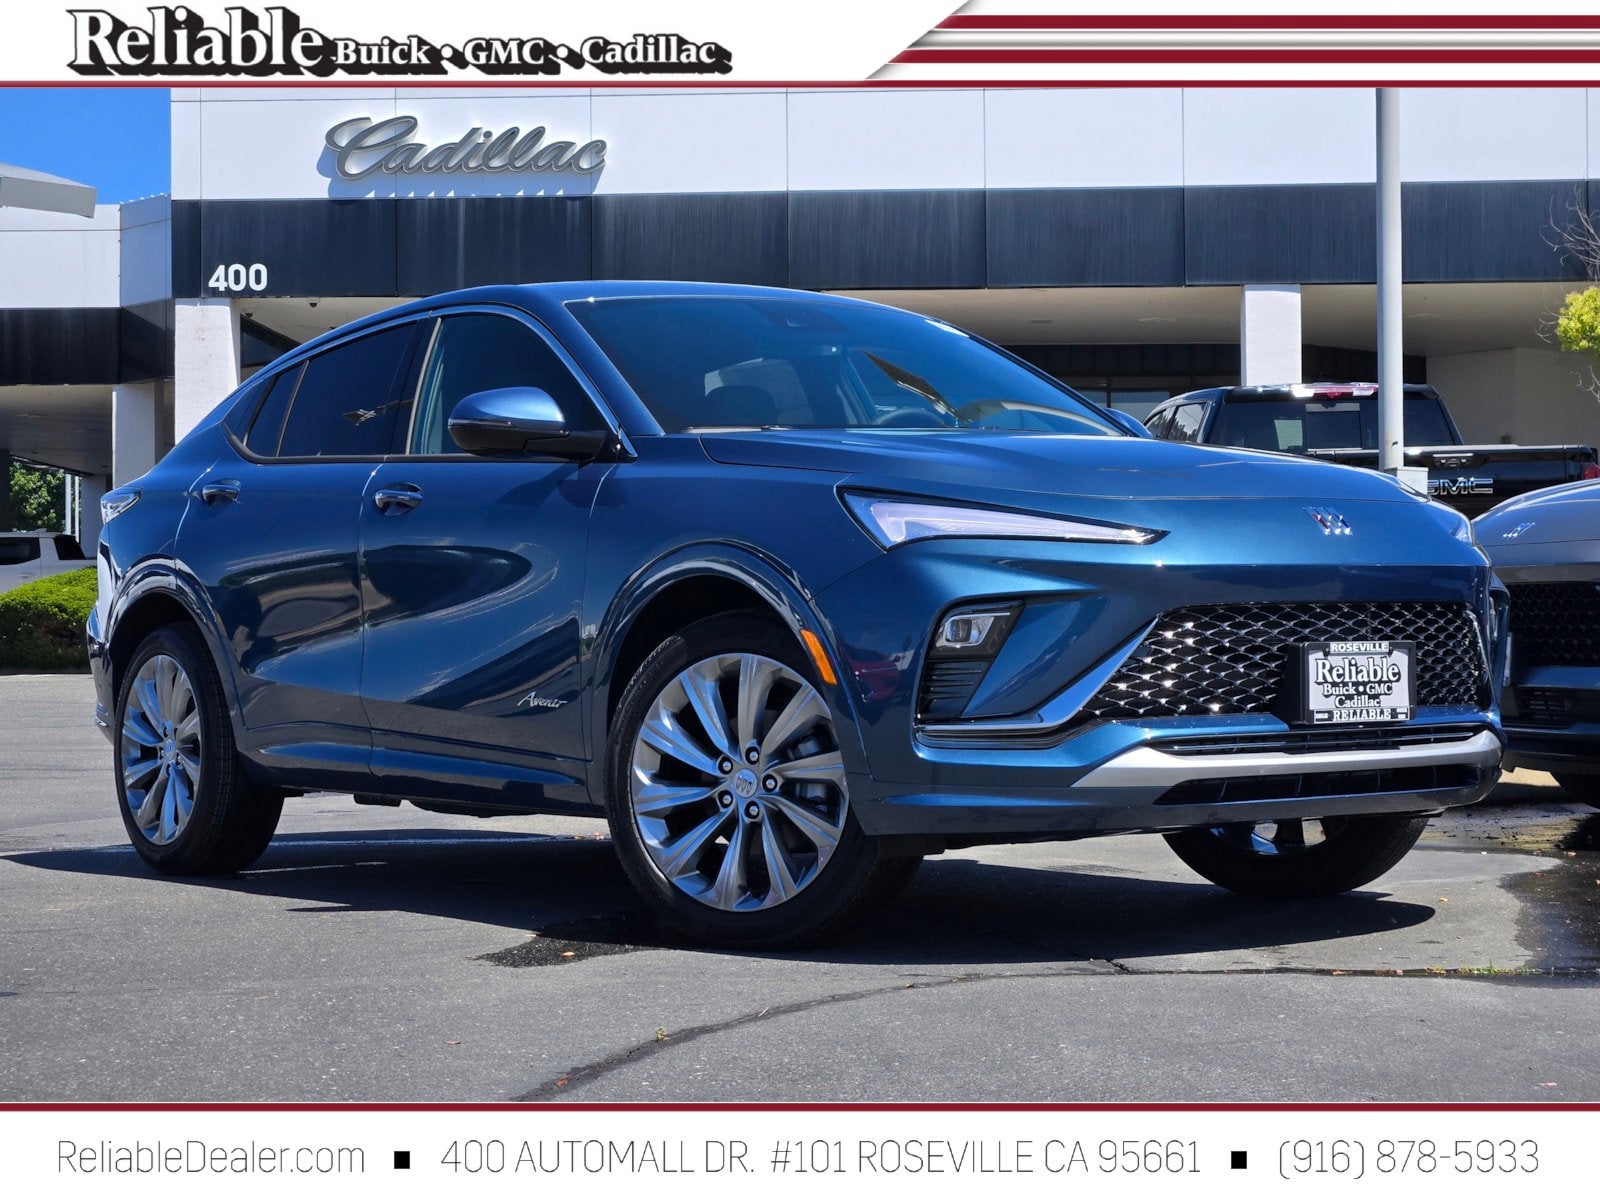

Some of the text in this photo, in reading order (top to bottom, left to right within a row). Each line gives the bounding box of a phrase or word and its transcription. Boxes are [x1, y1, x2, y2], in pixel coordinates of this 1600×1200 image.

[324, 115, 607, 181] Cadillac
[208, 263, 269, 292] 400
[1331, 642, 1389, 652] ROSEVILLE
[1315, 656, 1400, 683] Reliable
[1322, 683, 1393, 696] Buick GMC
[517, 691, 568, 708] Avenir
[1335, 695, 1381, 707] Cadillac
[1332, 708, 1391, 721] RELIABLE
